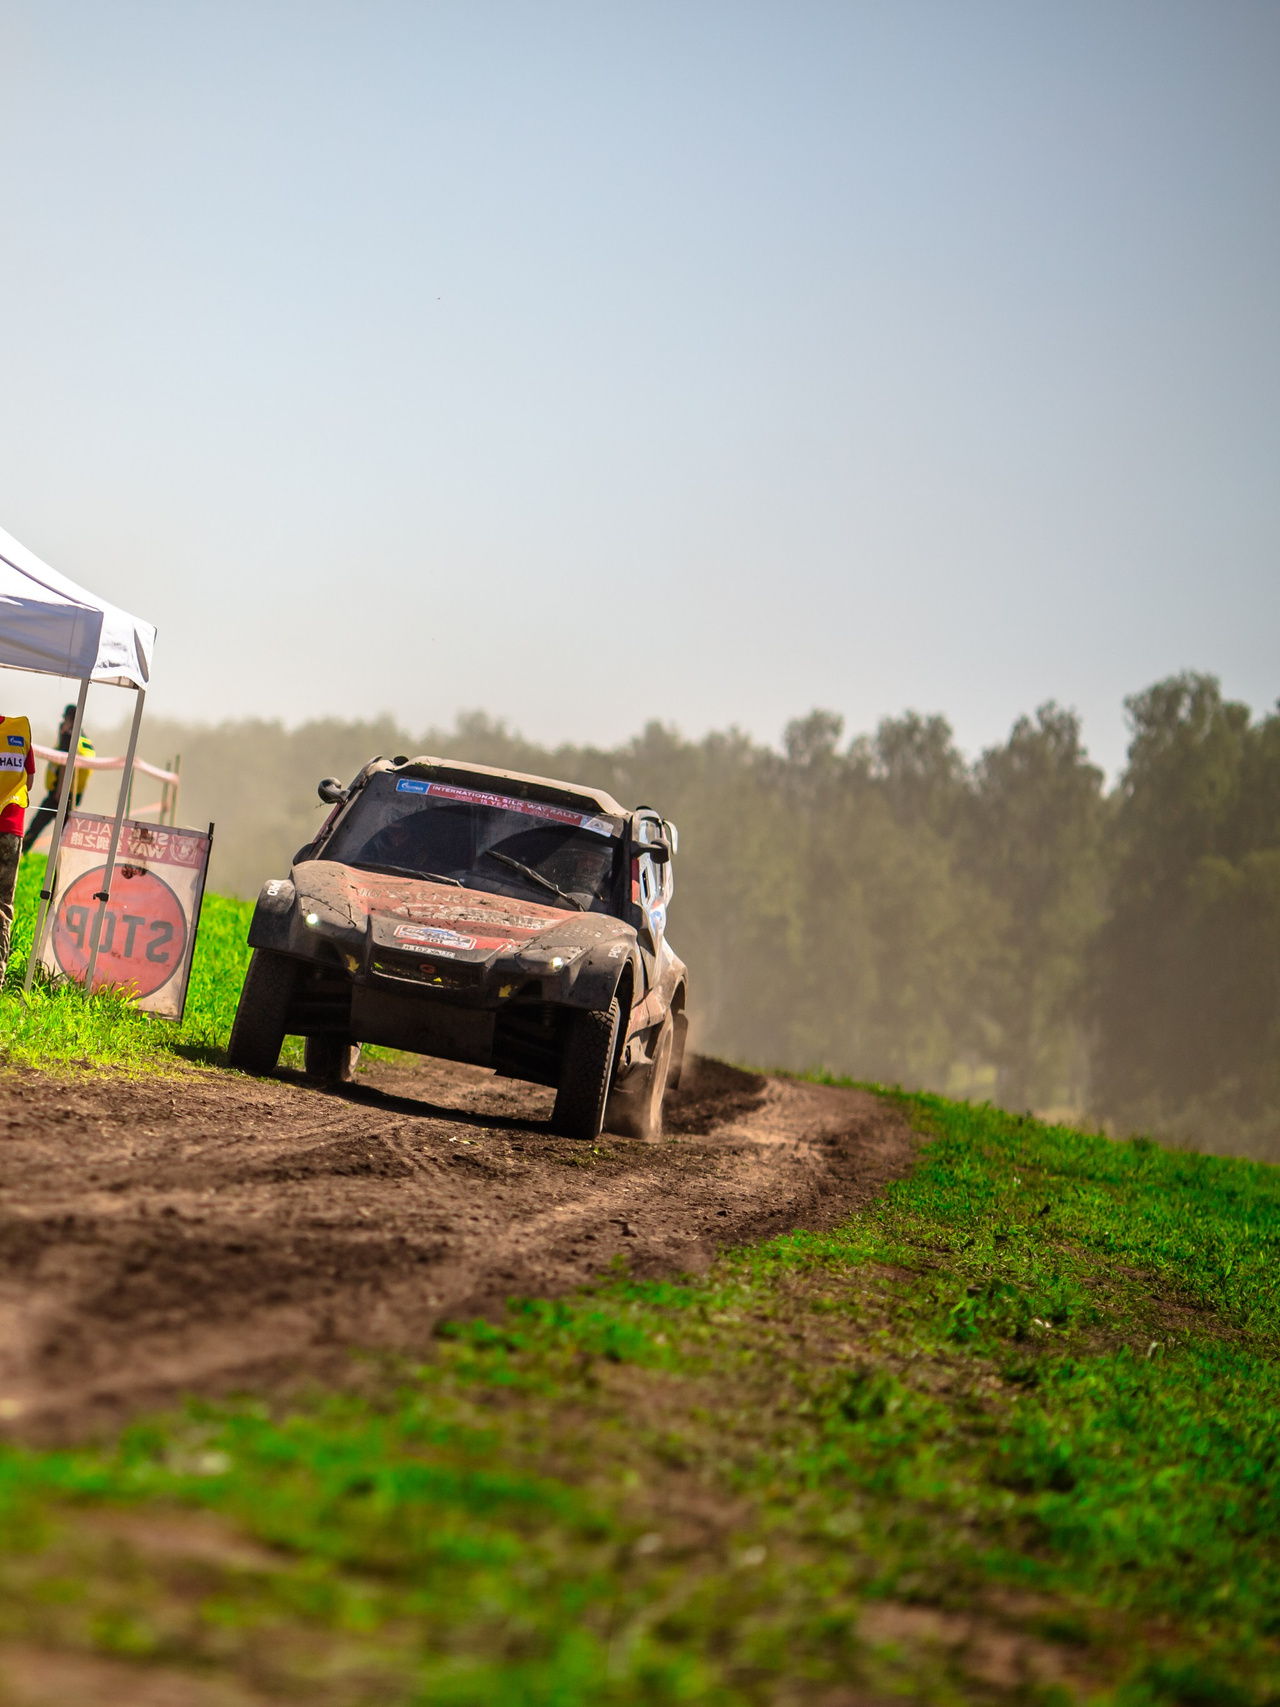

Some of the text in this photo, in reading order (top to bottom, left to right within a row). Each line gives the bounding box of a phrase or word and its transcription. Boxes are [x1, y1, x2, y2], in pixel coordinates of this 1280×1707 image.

[432, 785, 500, 802] INTERNATIONAL
[502, 798, 524, 808] SILK
[526, 803, 547, 813] WAY
[549, 808, 580, 819] RALLY
[491, 801, 522, 813] YEARS
